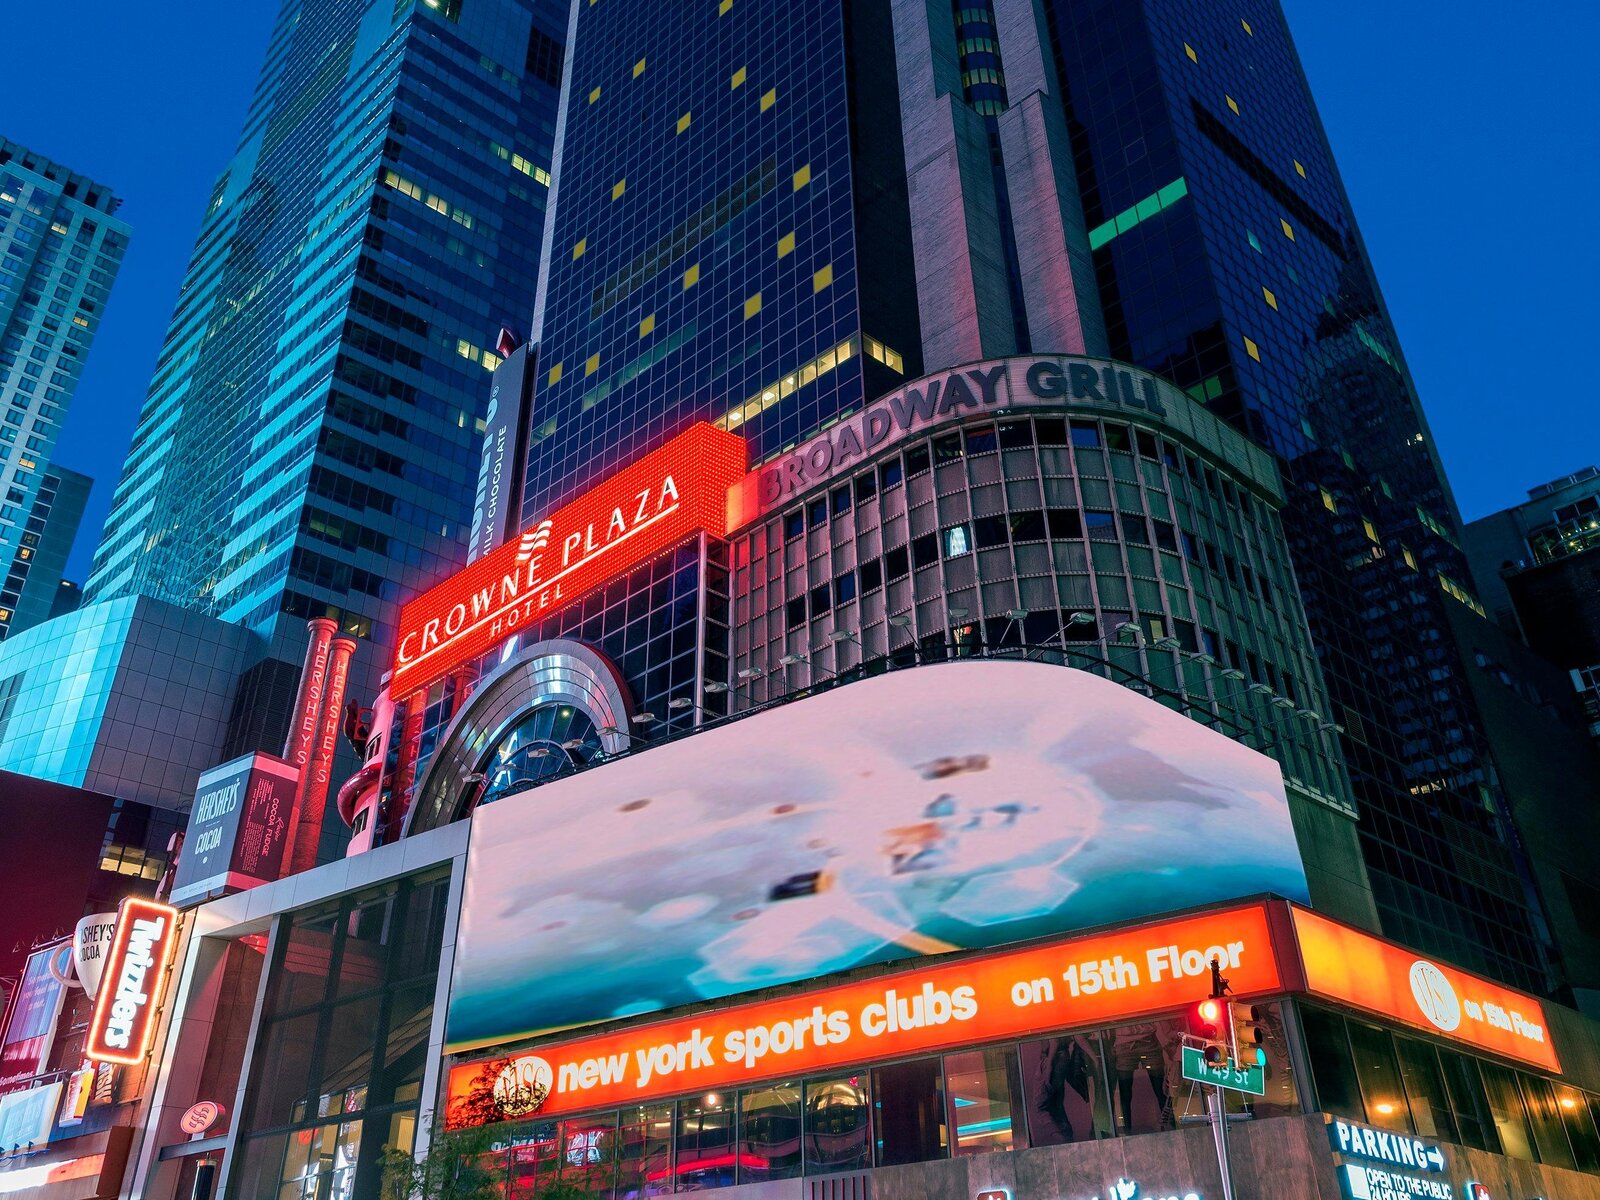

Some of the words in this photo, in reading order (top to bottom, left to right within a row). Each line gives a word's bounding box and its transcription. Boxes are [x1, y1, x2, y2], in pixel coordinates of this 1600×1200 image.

[760, 366, 1008, 504] BROADWAY
[1026, 360, 1167, 417] GRILL
[488, 424, 507, 519] CHOCOLATE
[398, 554, 544, 664] CROWNE
[562, 475, 680, 567] PLAZA
[491, 583, 565, 639] HOTEL
[268, 797, 279, 827] COCOA
[195, 826, 223, 855] COCOA
[261, 828, 273, 857] FUDGE
[104, 916, 164, 1049] Twizzlers
[557, 1052, 629, 1094] new
[636, 1029, 715, 1089] york
[723, 1004, 851, 1069] sports
[860, 982, 978, 1038] clubs
[1011, 977, 1054, 1007] on
[1063, 955, 1140, 997] 15th
[1146, 940, 1245, 983] Floor
[1464, 999, 1484, 1022] on
[1198, 1057, 1208, 1076] W
[1235, 1069, 1249, 1086] St
[1336, 1121, 1429, 1169] PARKING
[1366, 1167, 1391, 1186] OPEN
[1392, 1172, 1406, 1192] TO
[1404, 1176, 1422, 1196] THE
[1422, 1179, 1453, 1200] PUBLIC
